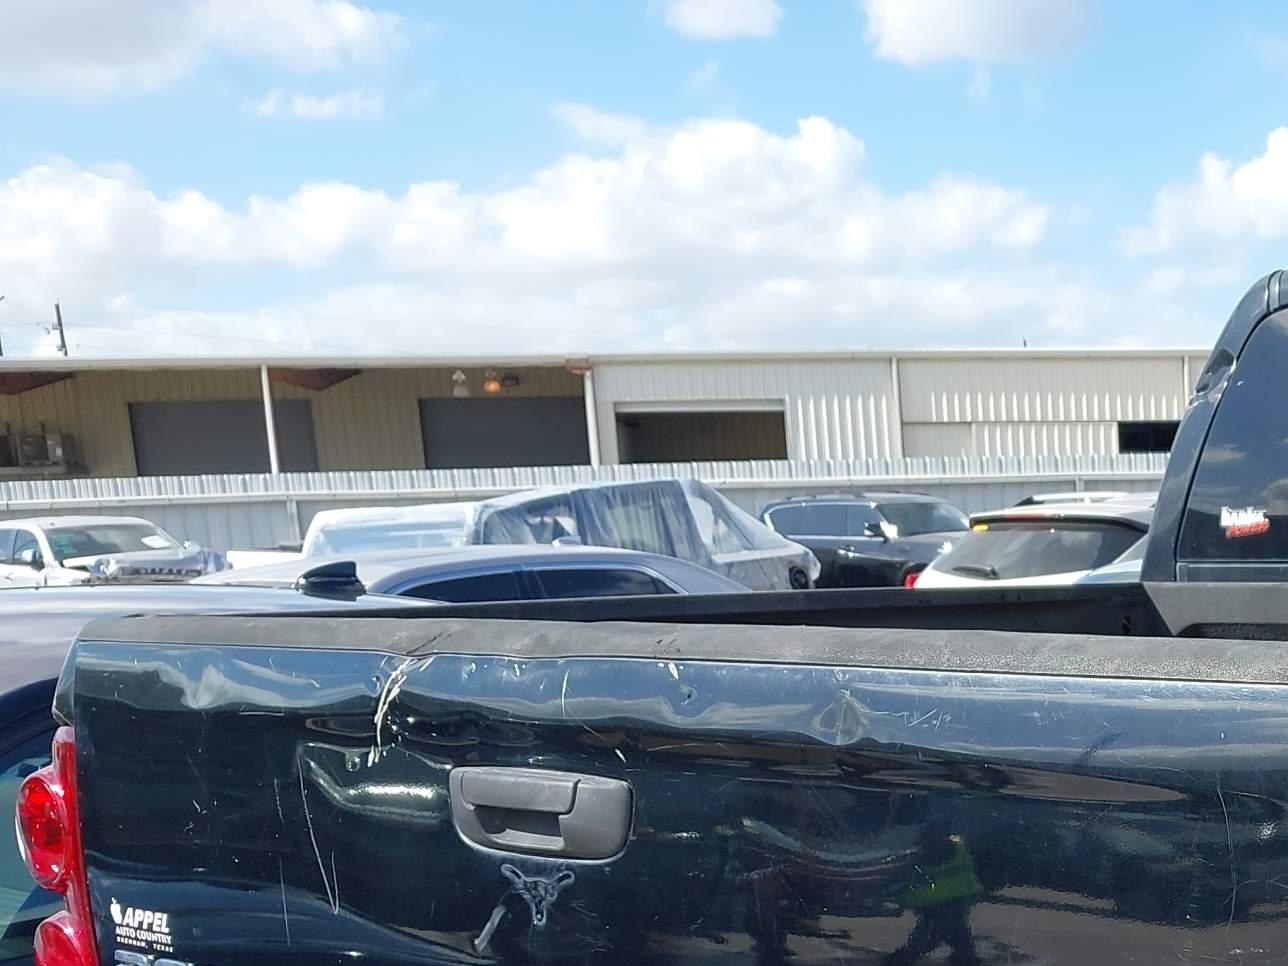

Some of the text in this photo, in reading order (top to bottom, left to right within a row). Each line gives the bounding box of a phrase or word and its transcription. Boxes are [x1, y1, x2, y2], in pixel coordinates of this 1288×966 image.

[122, 907, 170, 933] APPEL
[115, 925, 172, 945] AUTO COUNTRY
